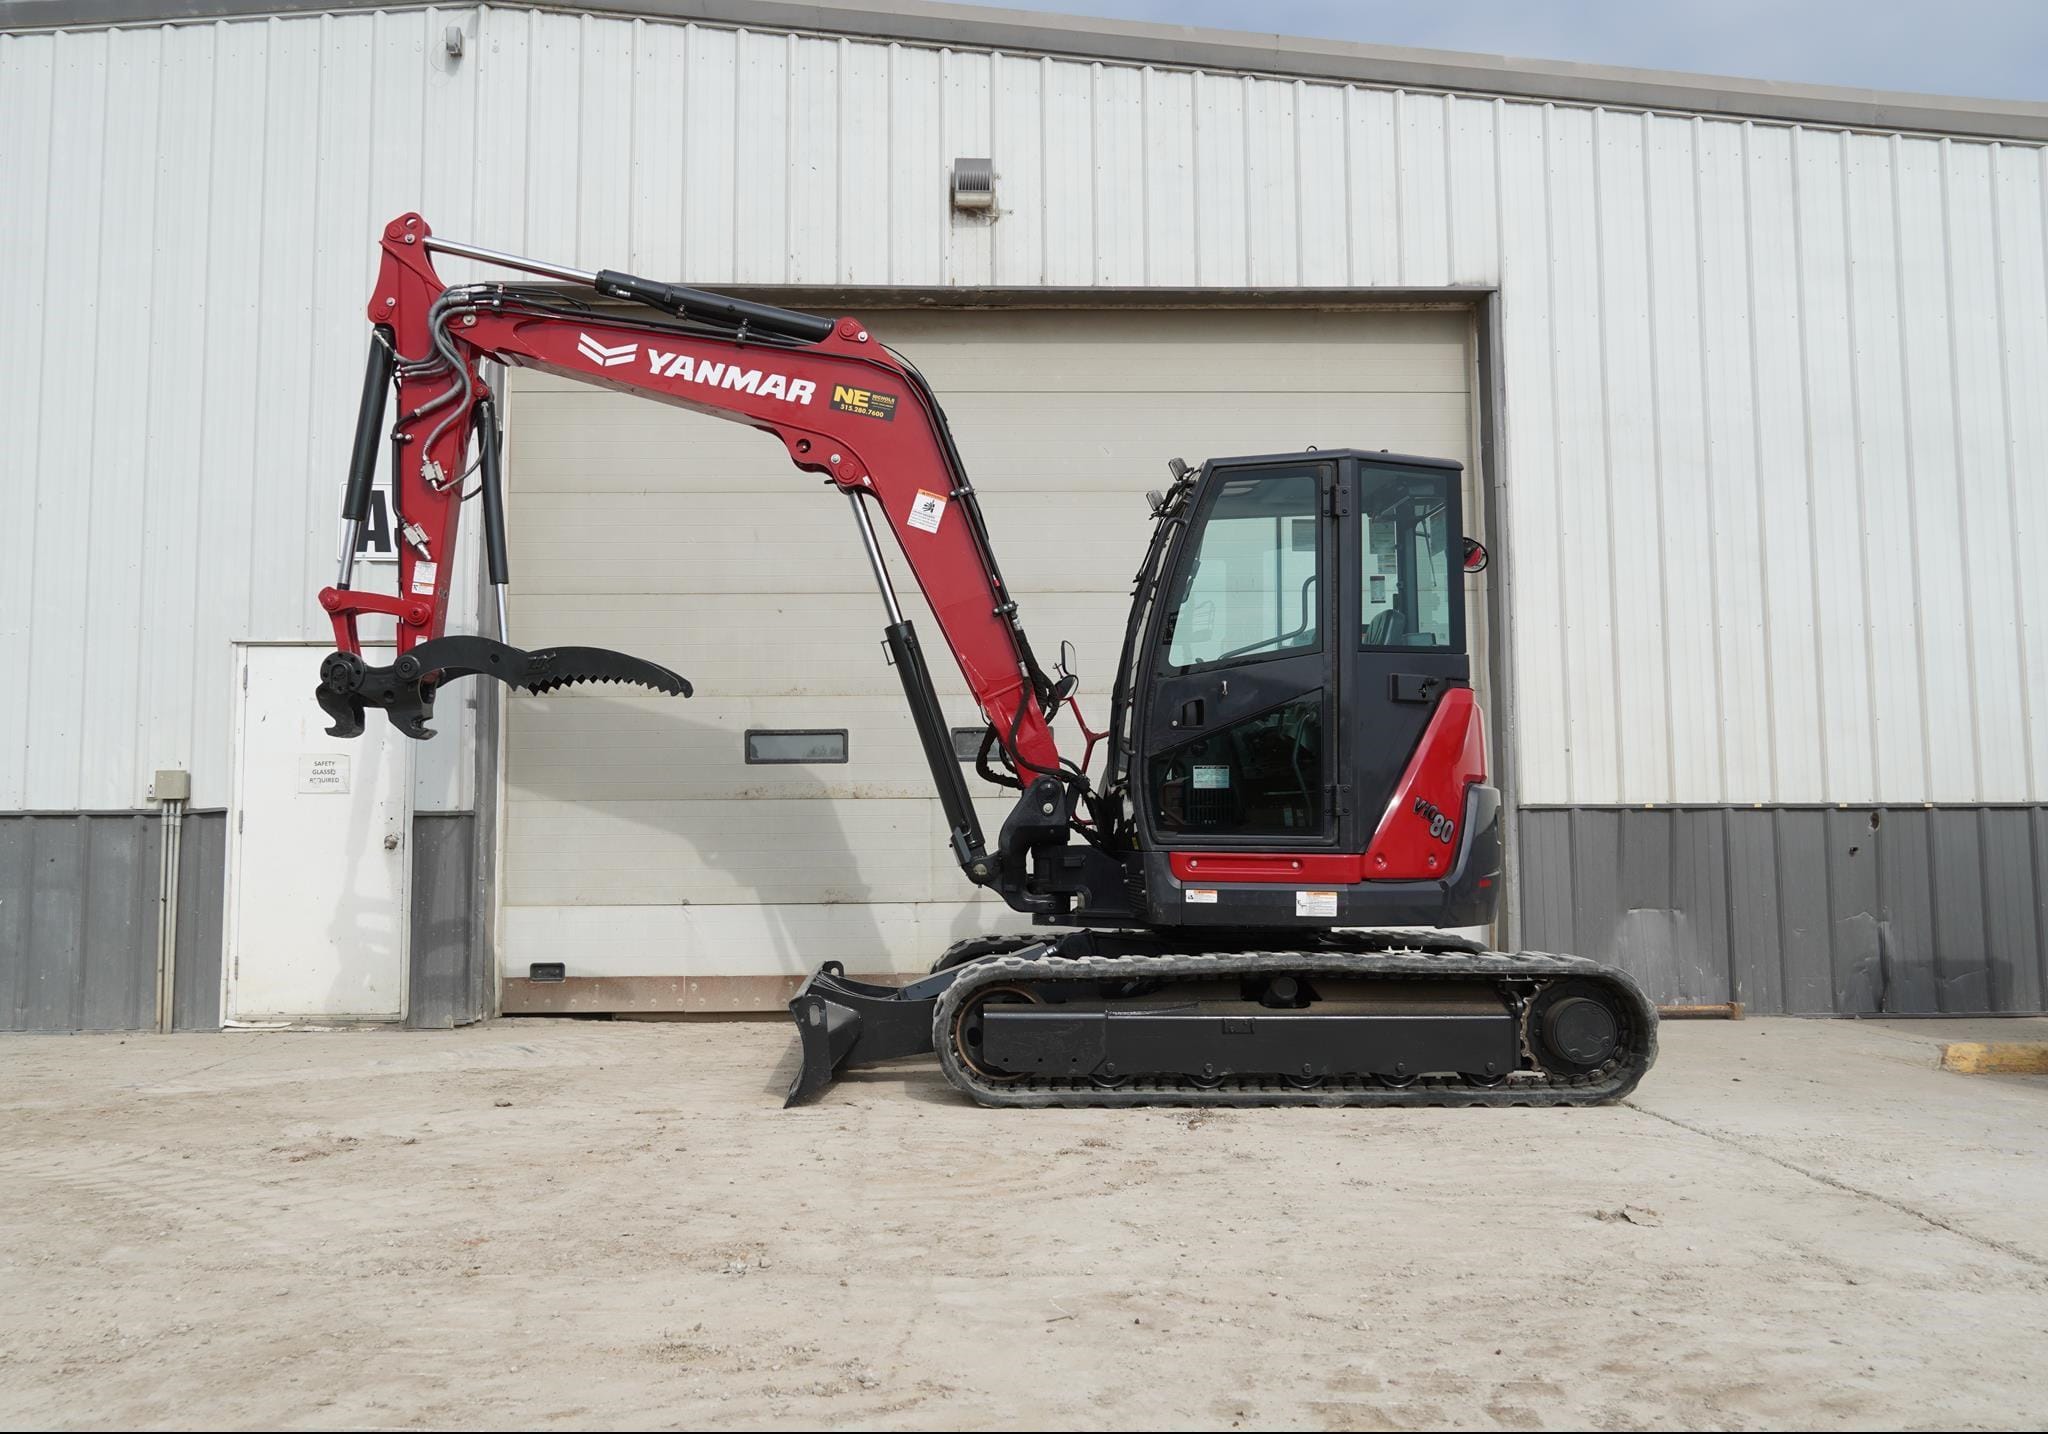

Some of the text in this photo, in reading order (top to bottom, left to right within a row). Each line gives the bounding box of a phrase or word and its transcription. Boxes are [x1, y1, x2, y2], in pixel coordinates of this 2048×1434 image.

[647, 348, 816, 405] YANMAR
[833, 385, 871, 408] NE
[840, 403, 884, 418] 515.280.7600
